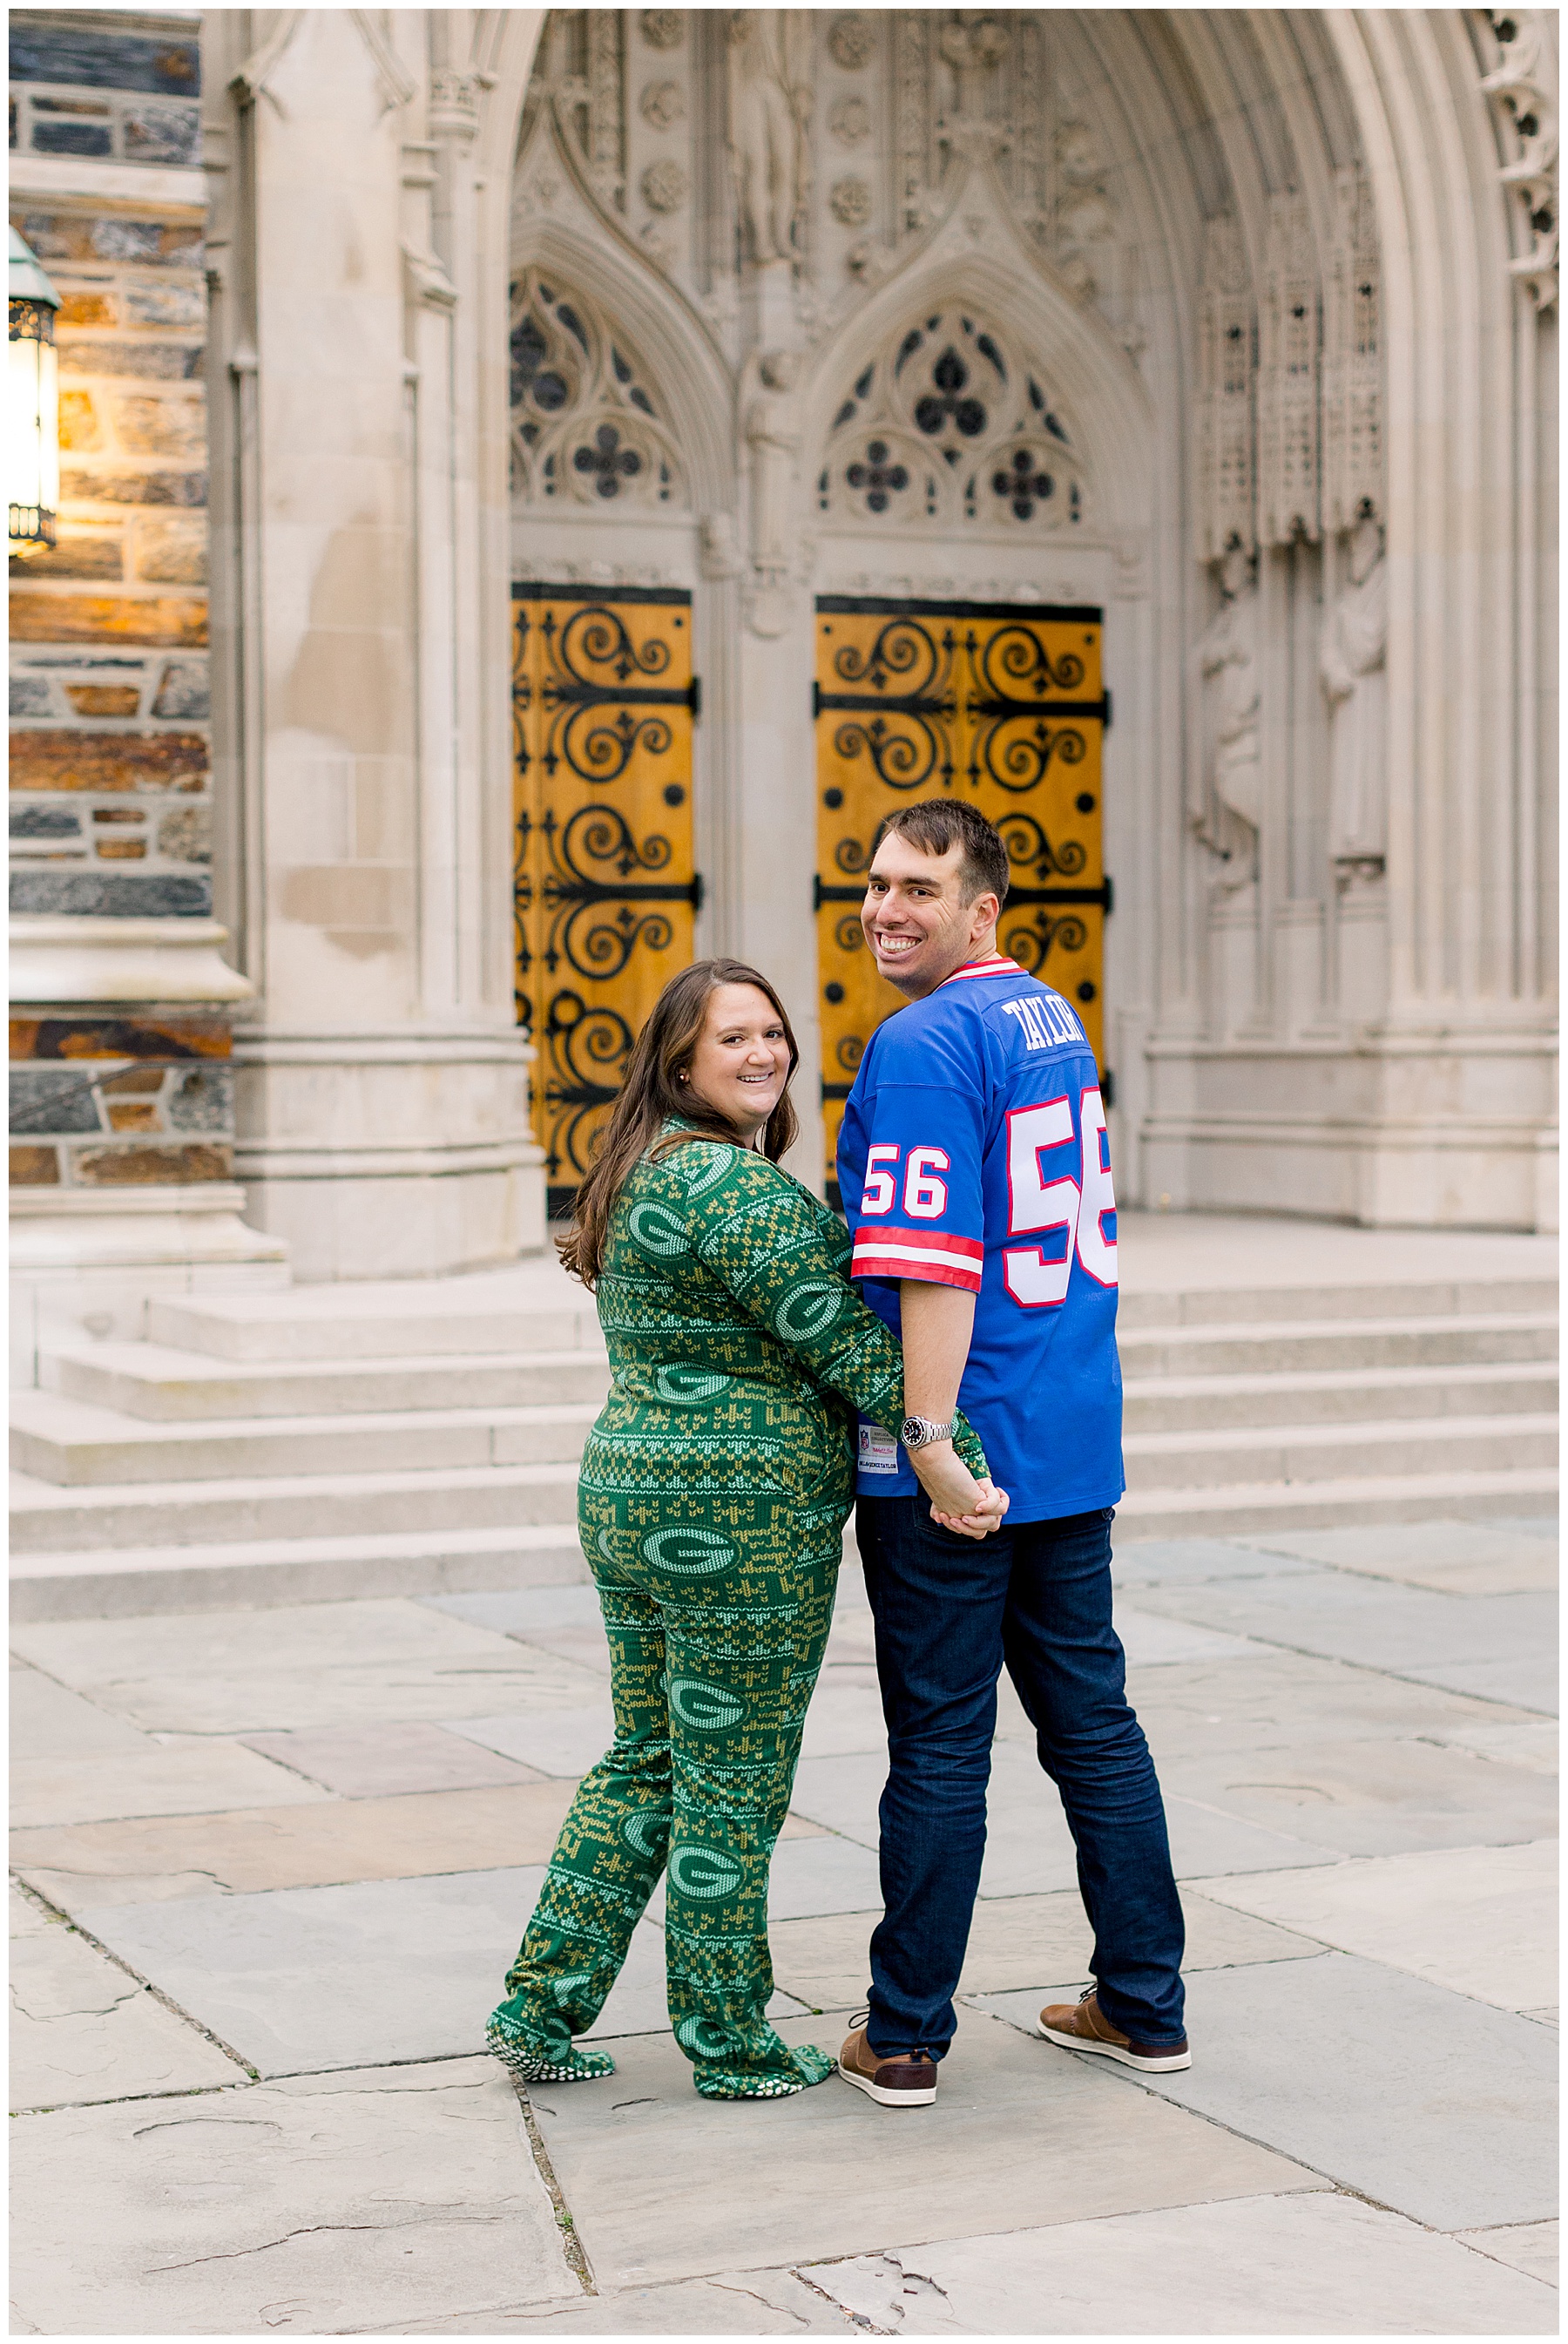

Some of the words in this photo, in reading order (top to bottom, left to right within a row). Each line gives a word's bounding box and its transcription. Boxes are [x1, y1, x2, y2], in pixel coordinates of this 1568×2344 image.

[1000, 994, 1085, 1052] TAYLOR
[860, 1143, 951, 1221] 56
[1002, 1086, 1119, 1308] 56
[629, 1202, 692, 1256] G
[775, 1281, 843, 1342] G
[657, 1360, 730, 1401] G
[643, 1528, 734, 1574] G
[670, 1678, 744, 1731] G
[670, 1846, 740, 1898] G
